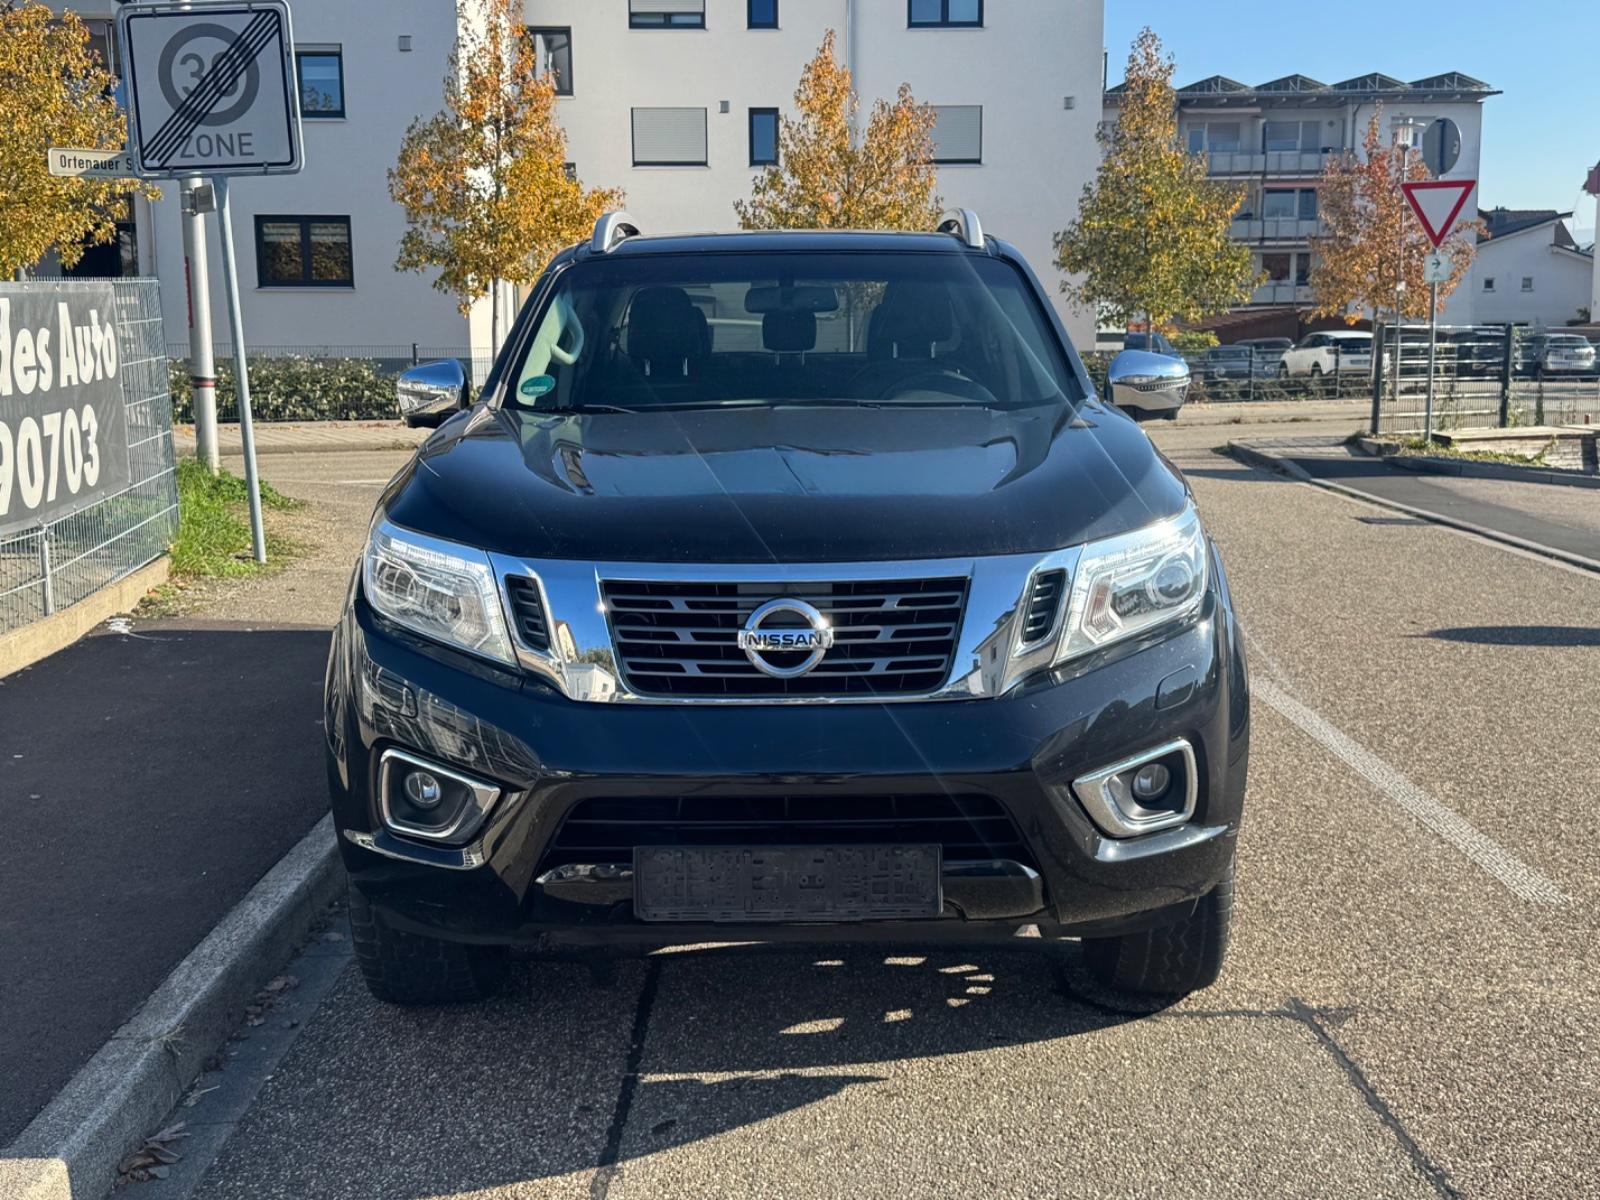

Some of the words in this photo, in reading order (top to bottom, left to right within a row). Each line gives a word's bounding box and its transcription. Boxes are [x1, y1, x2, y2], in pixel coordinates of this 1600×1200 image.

[179, 132, 255, 159] ZONE
[59, 154, 120, 171] Ortenauer
[125, 157, 134, 172] S
[58, 302, 117, 388] Auto
[747, 633, 823, 647] NISSAN
